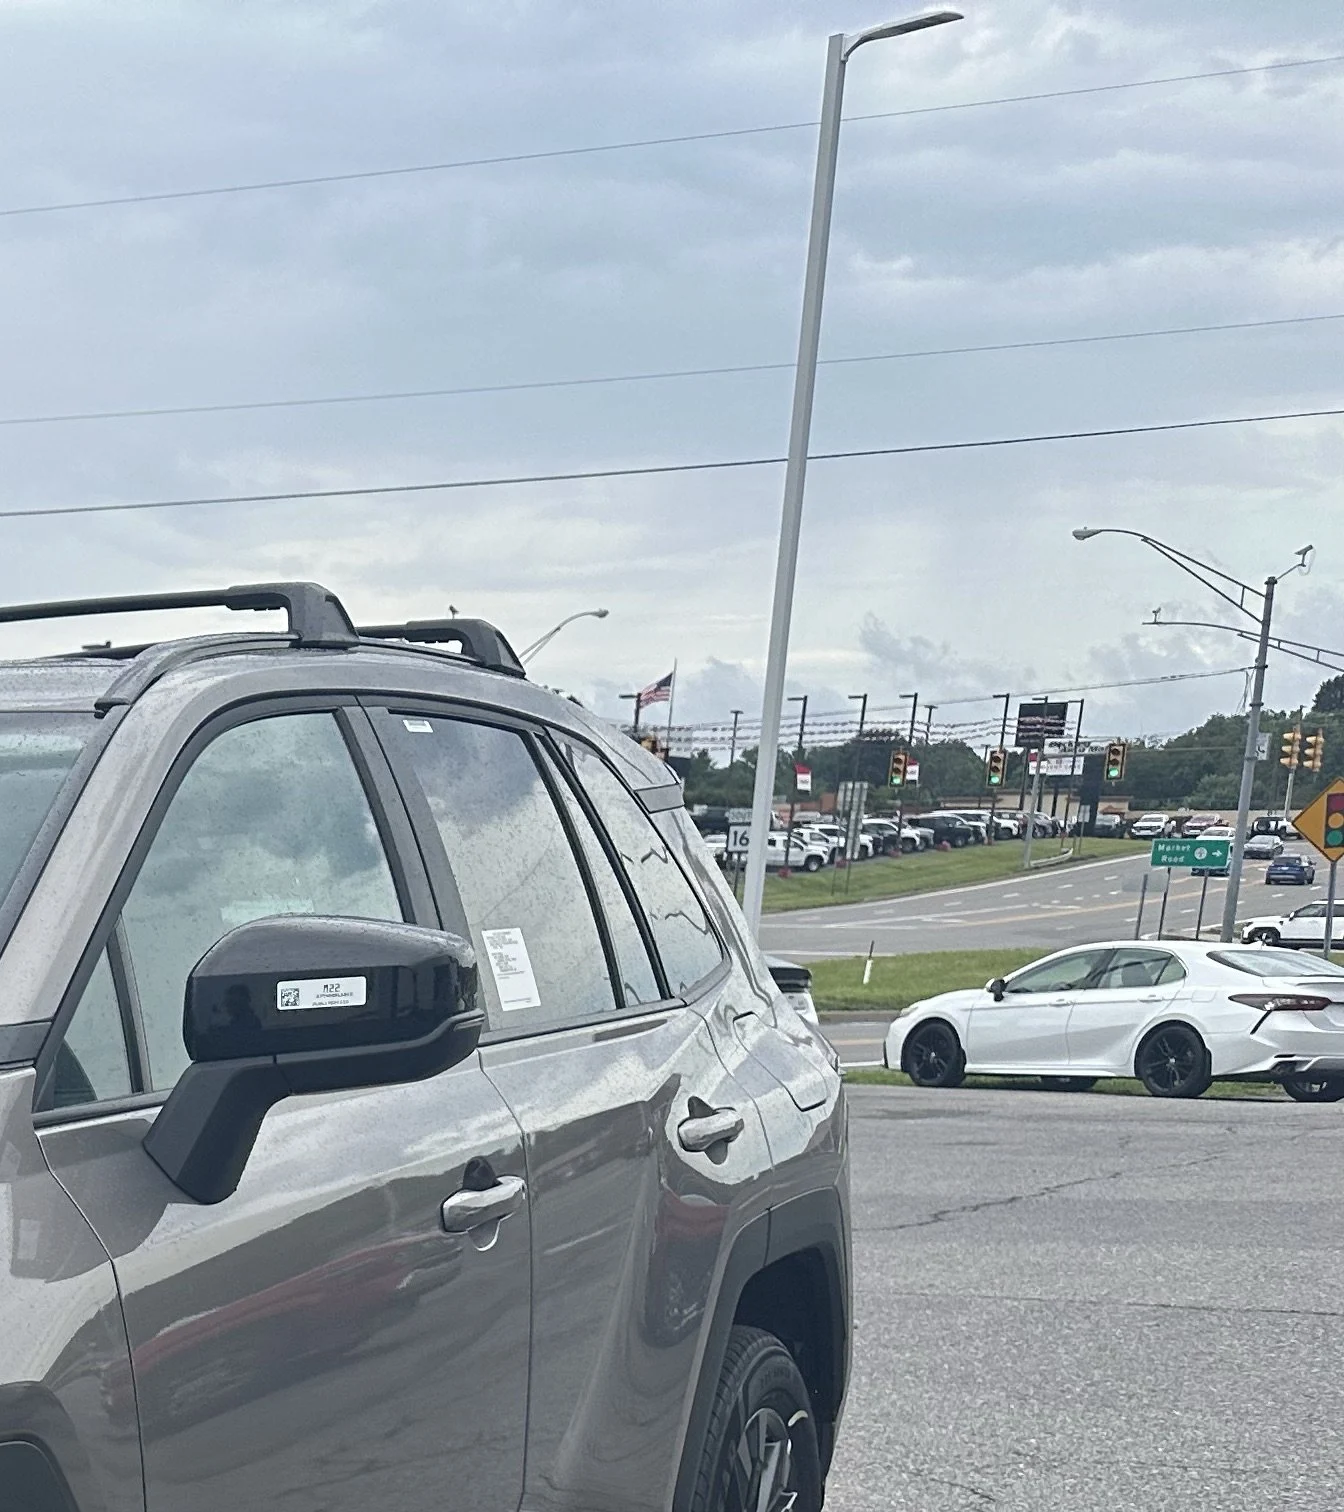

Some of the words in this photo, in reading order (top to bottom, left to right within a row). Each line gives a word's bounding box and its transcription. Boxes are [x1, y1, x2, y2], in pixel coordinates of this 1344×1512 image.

[733, 830, 750, 846] 16
[1158, 844, 1191, 852] Market
[1161, 855, 1185, 863] Road
